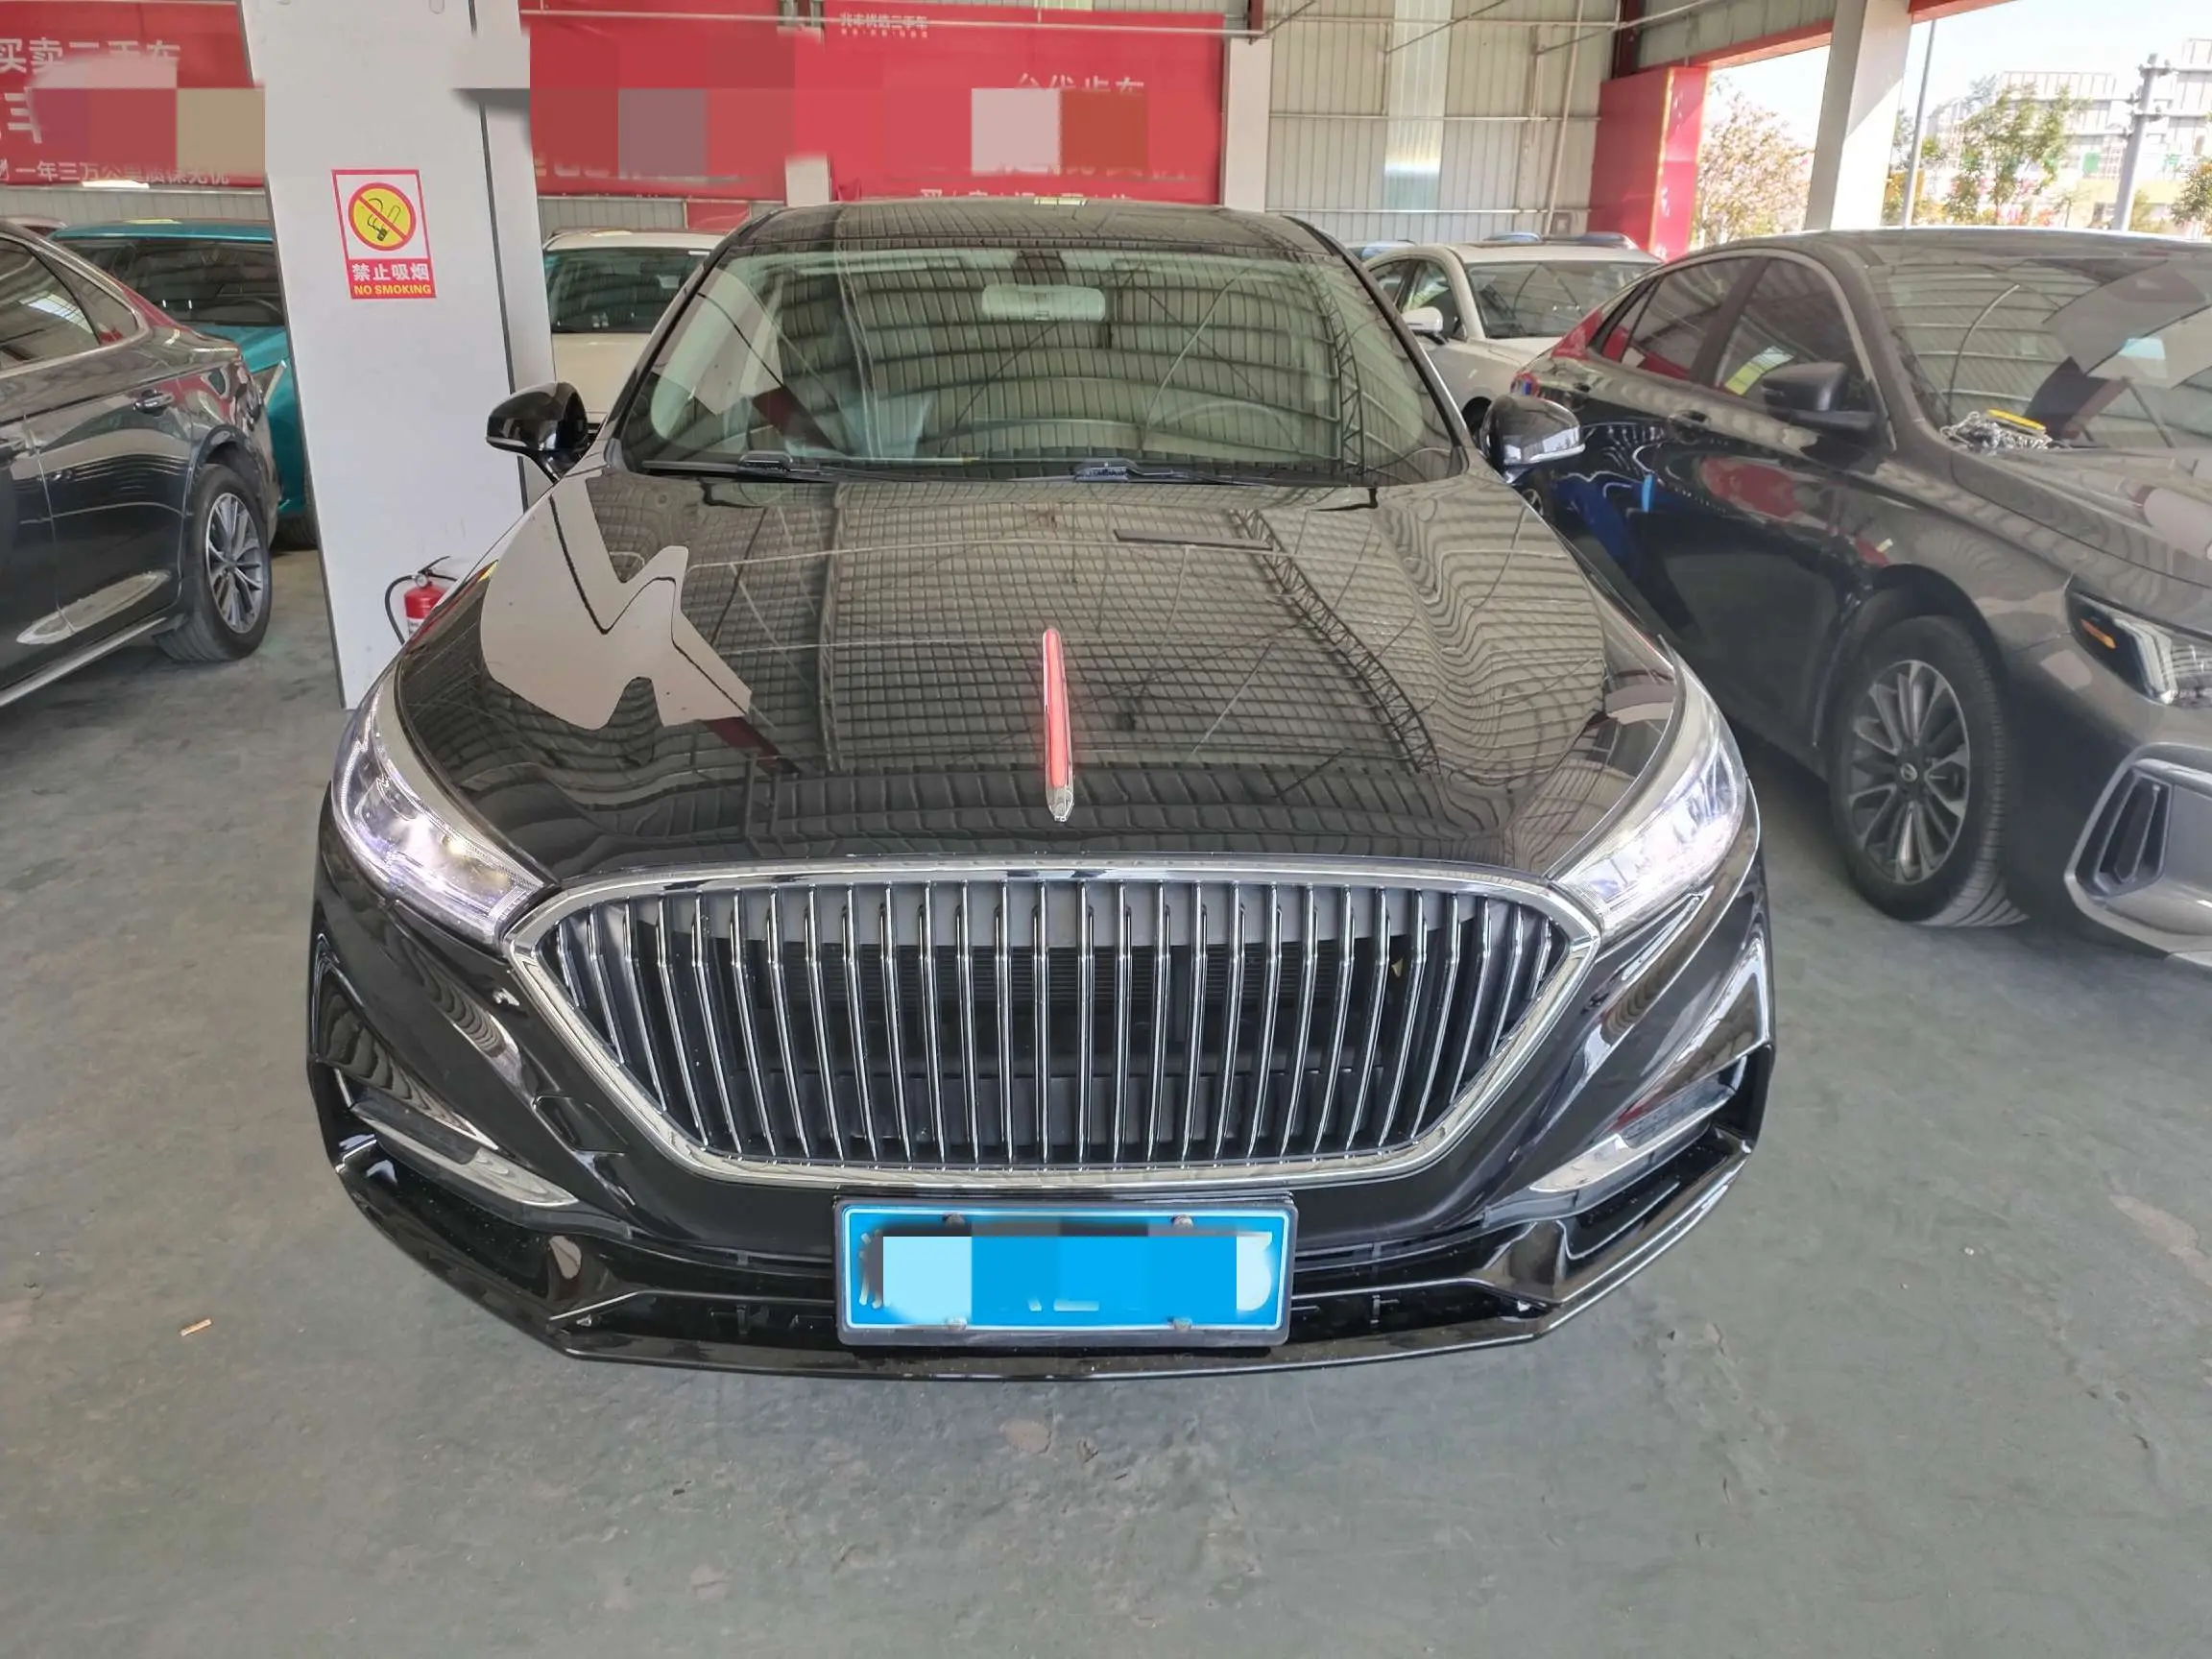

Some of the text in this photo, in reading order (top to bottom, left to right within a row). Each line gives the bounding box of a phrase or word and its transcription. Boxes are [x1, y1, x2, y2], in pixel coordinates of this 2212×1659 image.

[352, 263, 430, 281] 禁止吸烟
[353, 284, 431, 295] NO SMOKING
